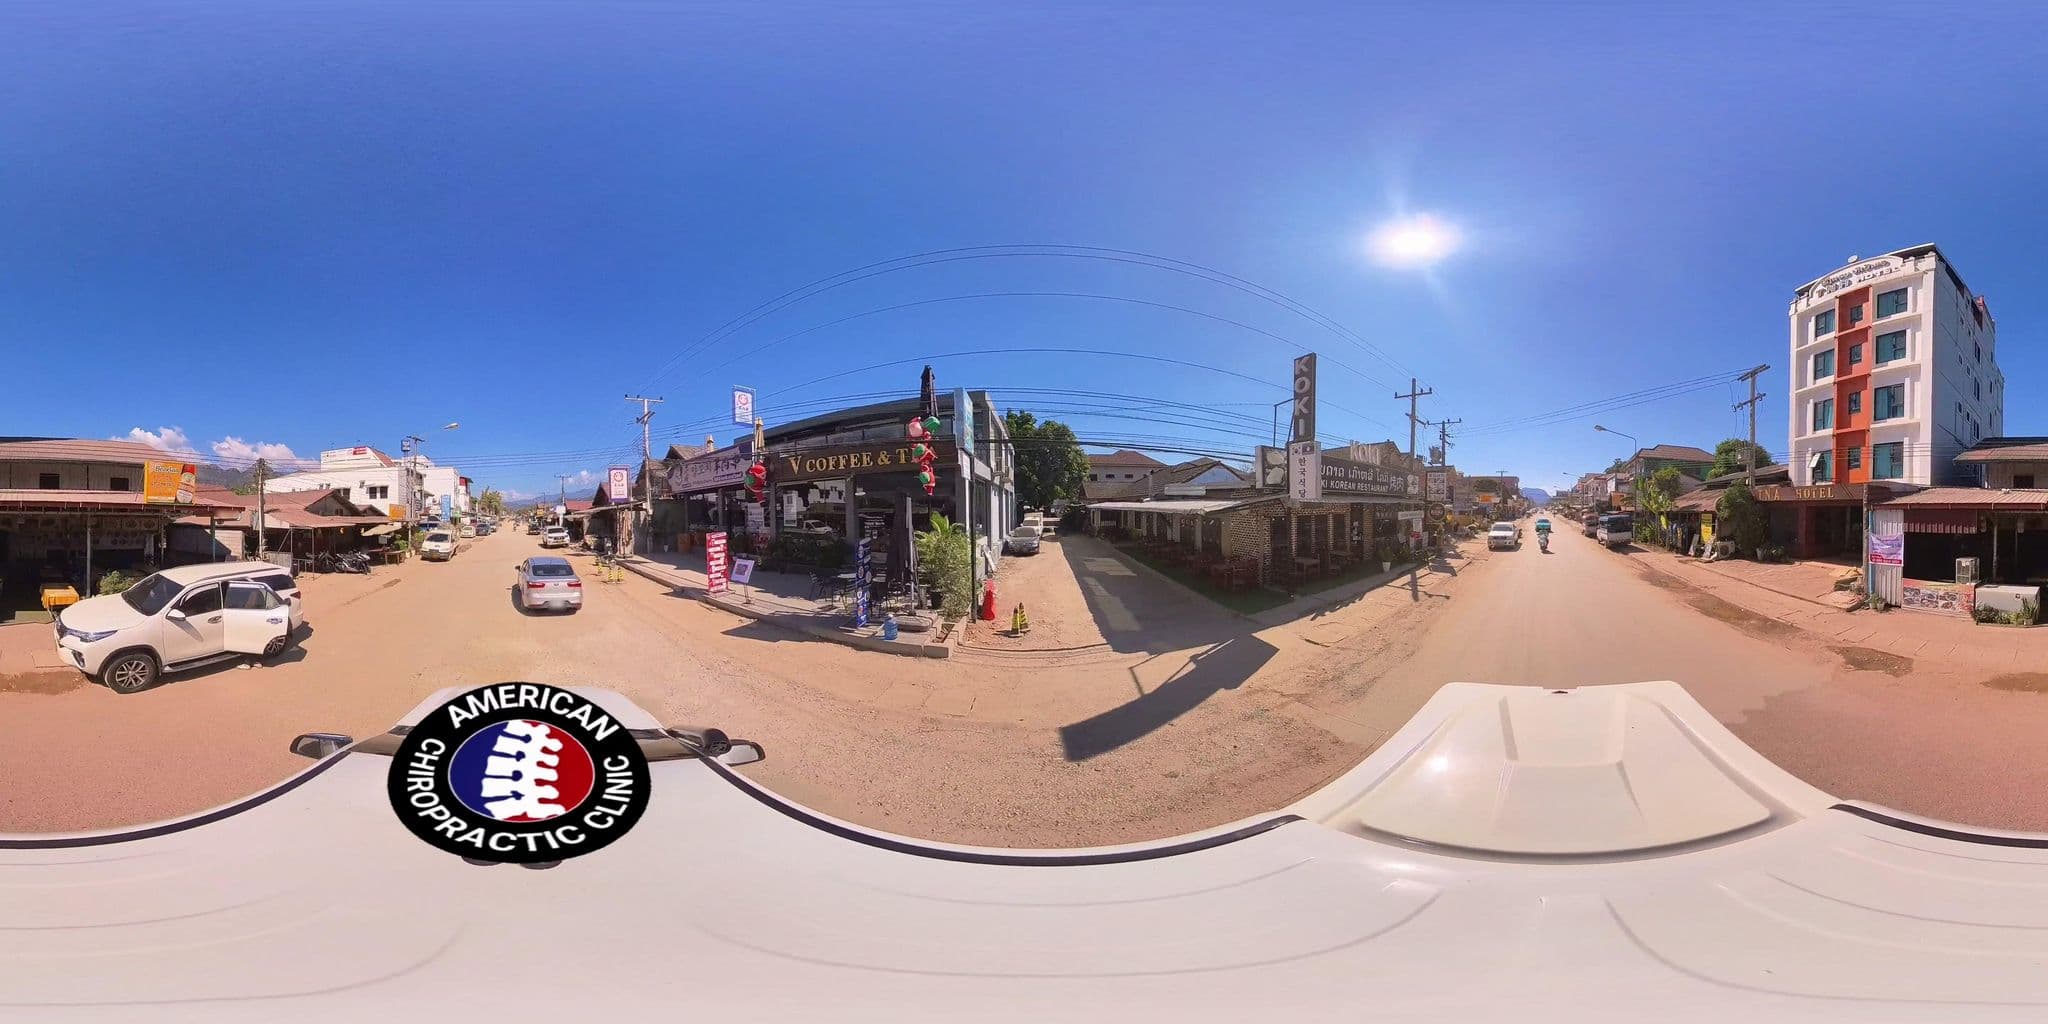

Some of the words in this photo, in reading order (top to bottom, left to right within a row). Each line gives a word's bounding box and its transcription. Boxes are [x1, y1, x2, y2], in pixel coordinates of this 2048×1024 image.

[1294, 356, 1311, 436] KOKI
[789, 455, 802, 476] V
[805, 451, 874, 473] COFFEE
[877, 450, 892, 466] &
[1297, 456, 1308, 498] 한국식당
[1330, 480, 1357, 490] KOREAN
[1357, 482, 1389, 493] RESTAURANT
[1795, 487, 1834, 499] HOTEL
